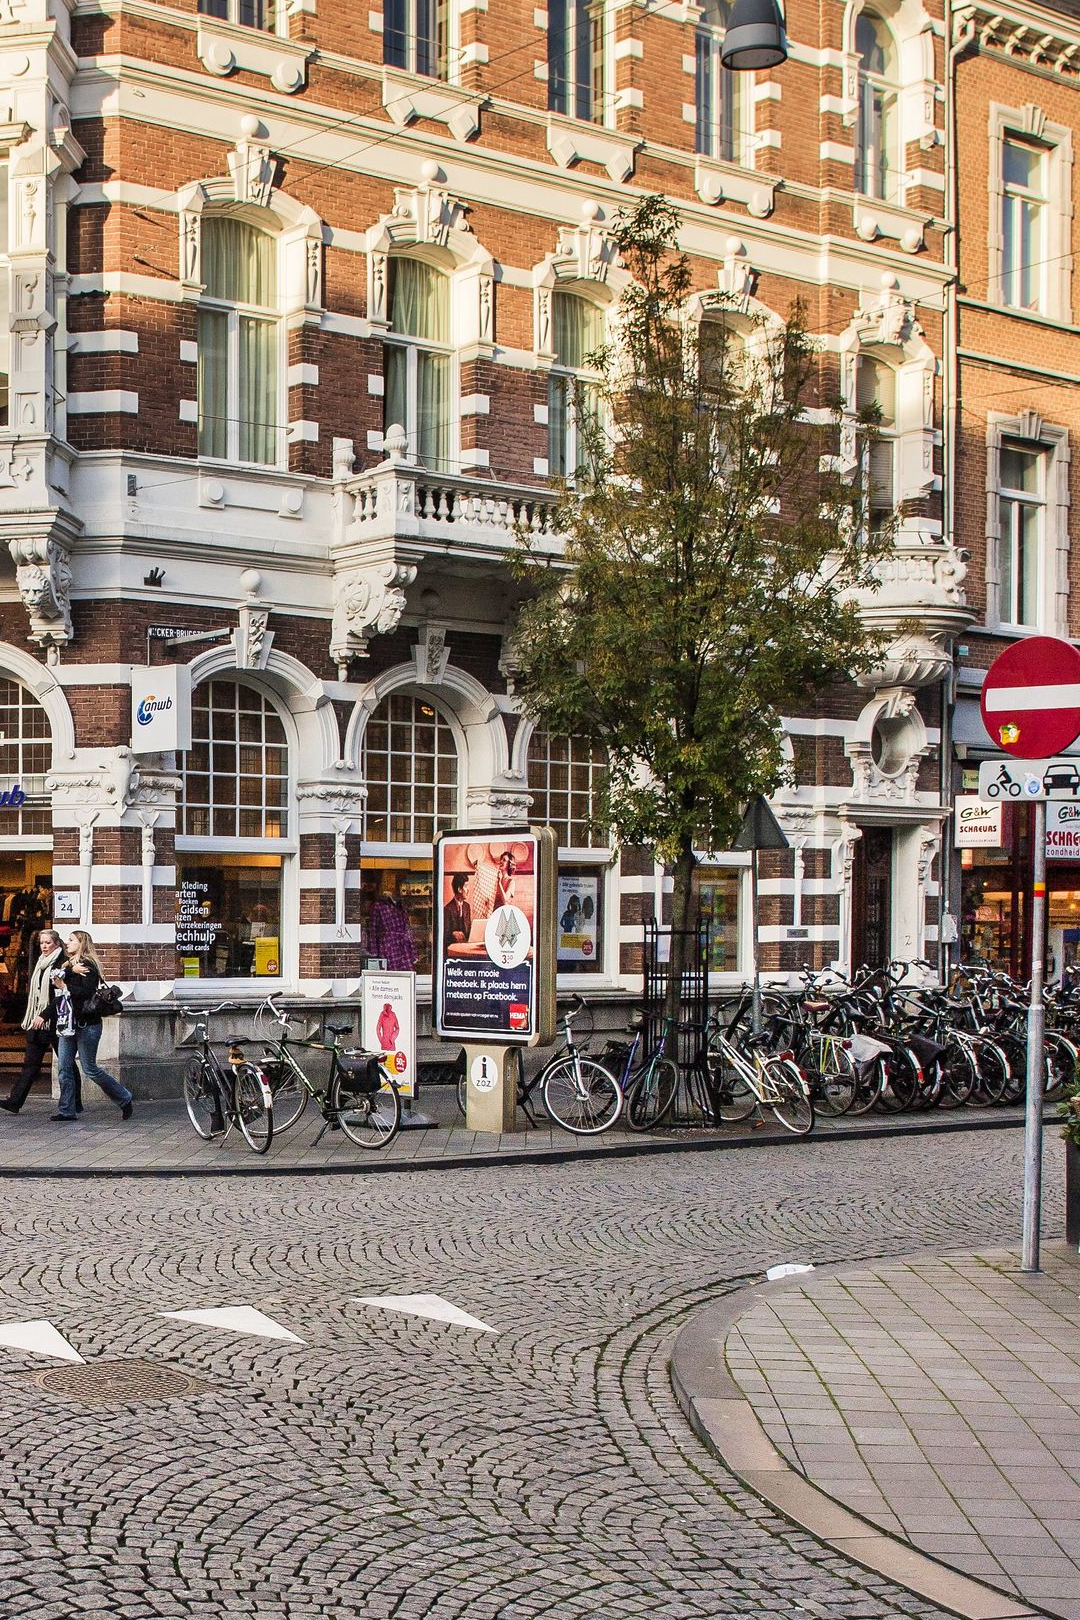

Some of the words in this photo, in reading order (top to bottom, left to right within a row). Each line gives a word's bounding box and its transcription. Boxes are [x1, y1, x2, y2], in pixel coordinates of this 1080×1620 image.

[144, 696, 173, 712] anwb
[959, 825, 997, 833] SCHREURS
[181, 881, 209, 892] Kleding
[60, 903, 74, 913] 24
[180, 905, 209, 915] Gidsen
[174, 913, 192, 921] izen
[176, 921, 222, 931] Verzekeringen
[175, 930, 216, 945] echhulp
[176, 943, 194, 951] Credit
[447, 968, 463, 977] Welk
[477, 969, 500, 978] mooie
[446, 979, 479, 988] theedoek.
[487, 980, 510, 990] plaats
[510, 981, 527, 990] hem
[446, 991, 473, 999] meteen
[473, 992, 482, 1001] op
[482, 992, 518, 1001] Facebook.
